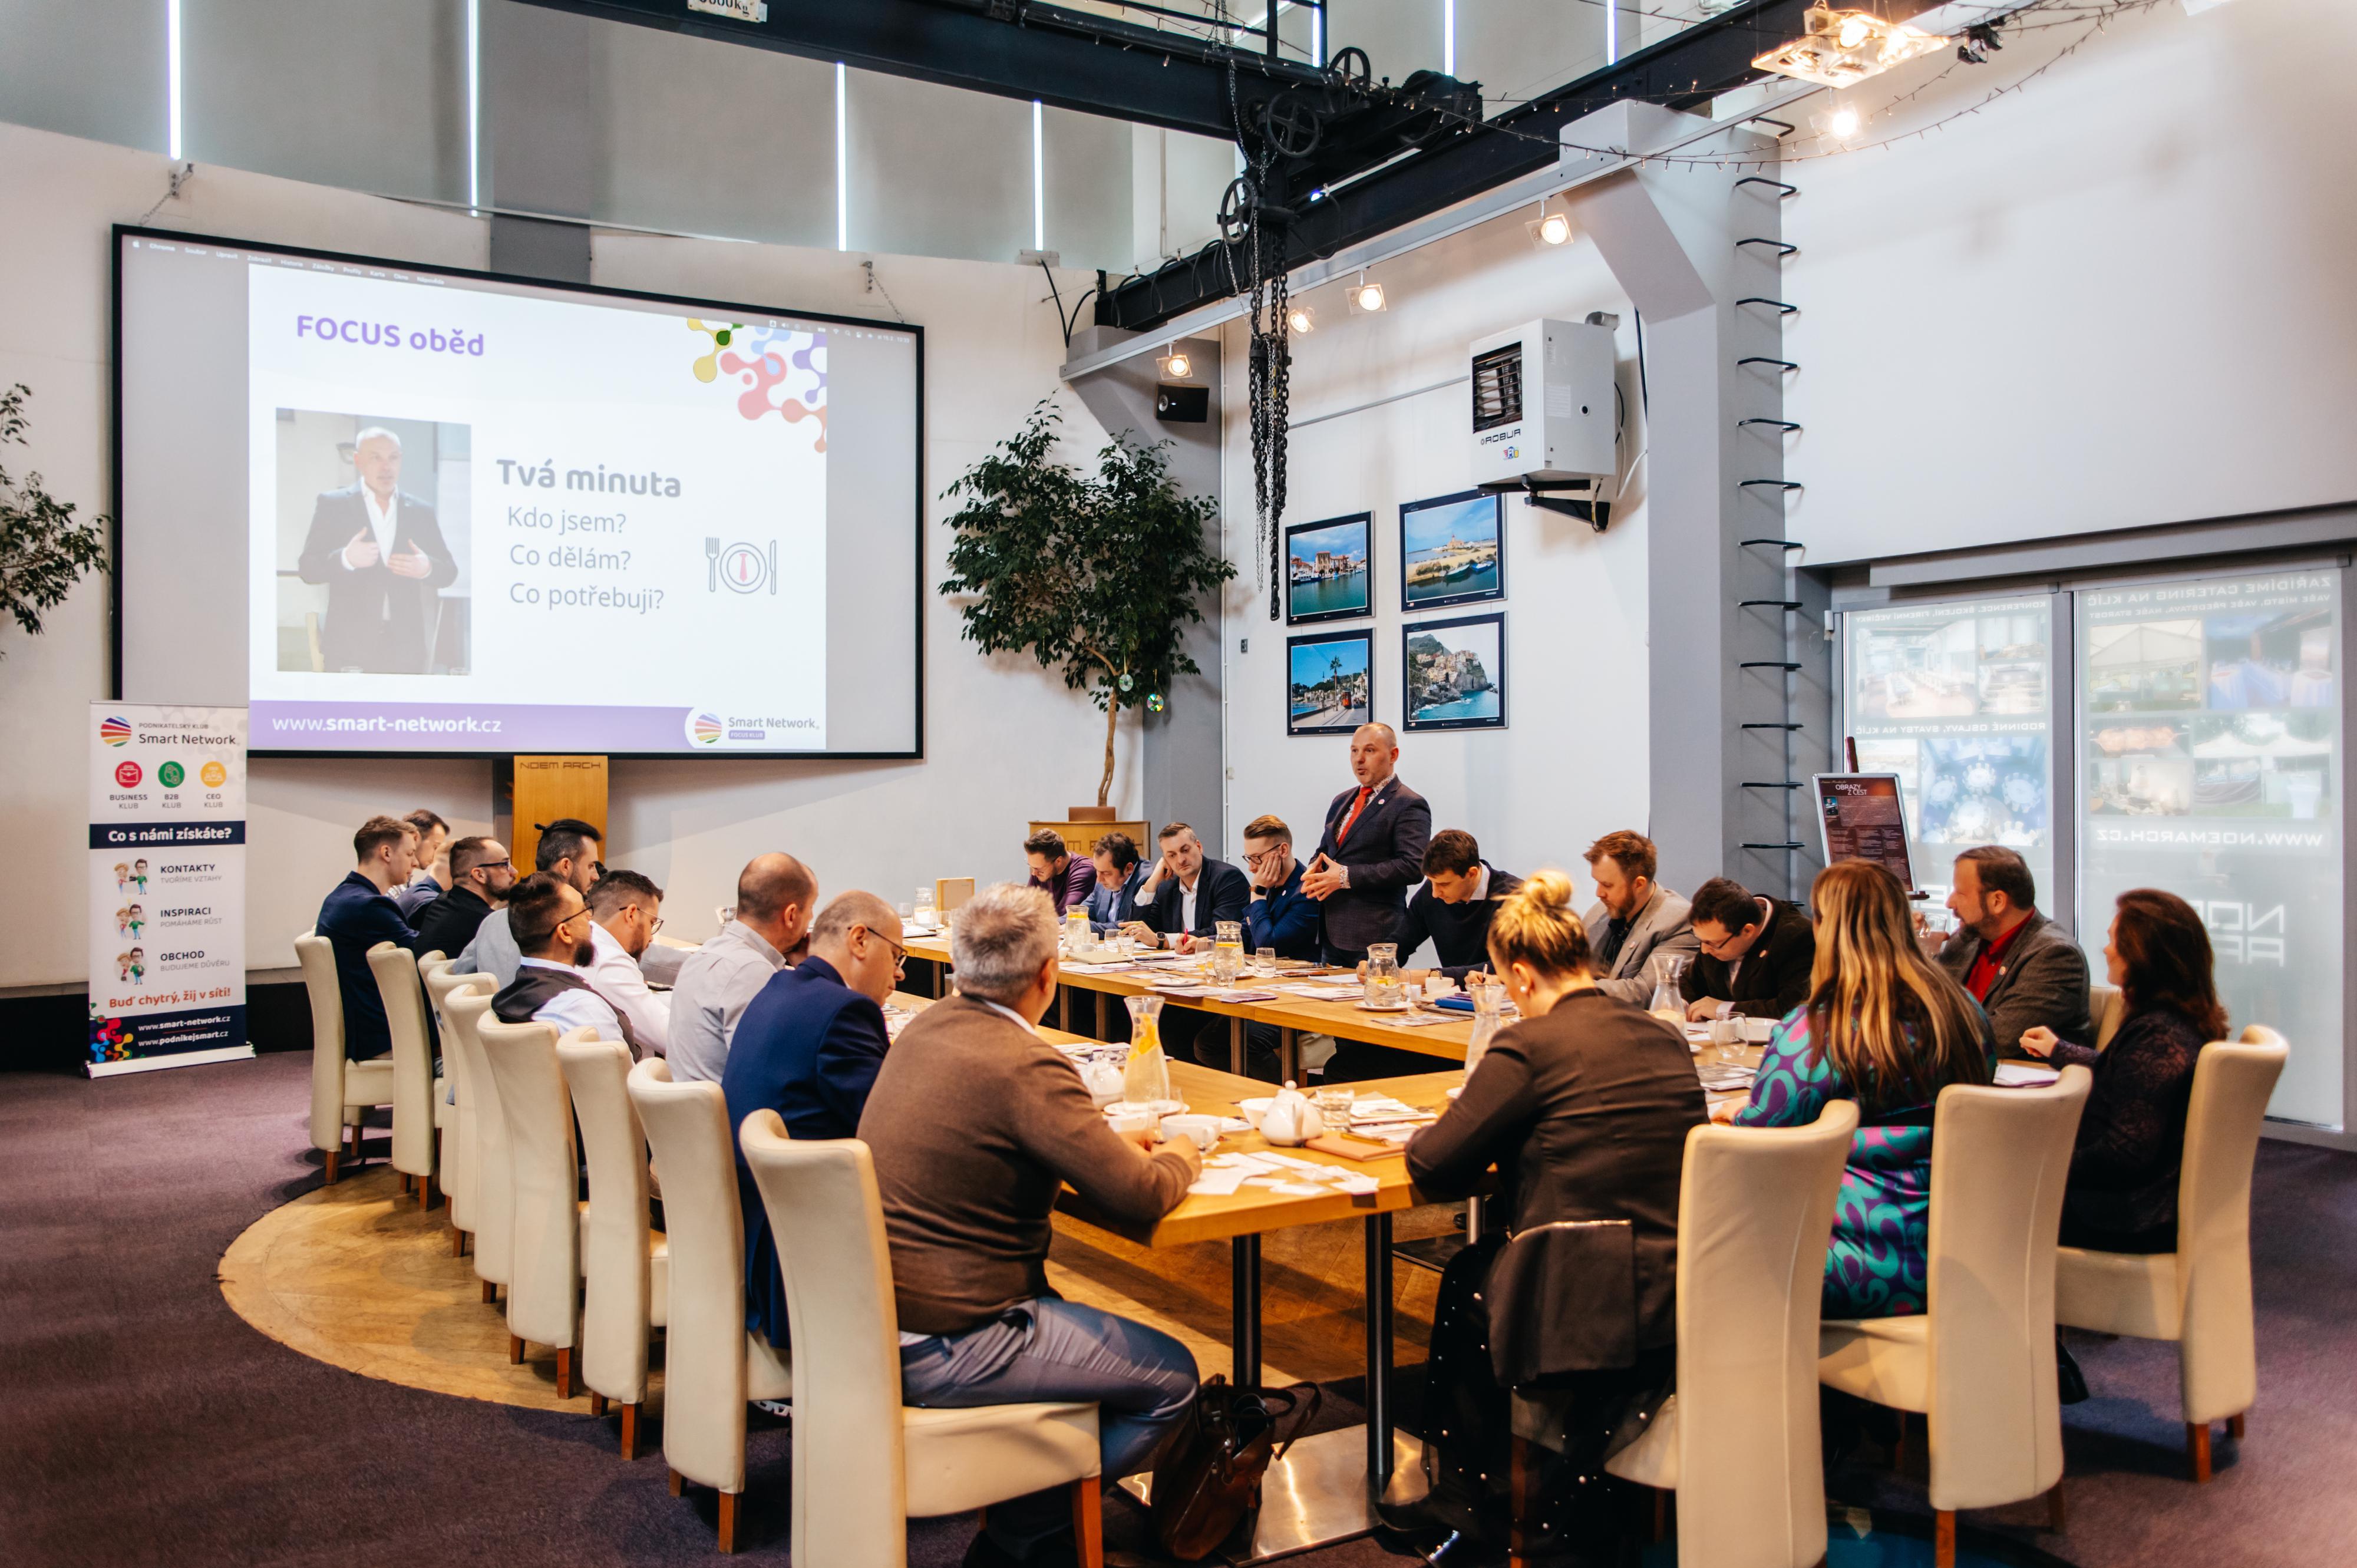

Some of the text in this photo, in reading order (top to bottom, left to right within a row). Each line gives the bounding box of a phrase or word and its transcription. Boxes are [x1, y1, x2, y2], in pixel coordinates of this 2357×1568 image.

[298, 315, 484, 356] FOCUS oběd
[1485, 428, 1521, 444] ROBUR
[496, 458, 681, 497] Tvá minuta
[508, 506, 626, 536] Kdo jsem?
[510, 544, 630, 570] Co dělám?
[510, 583, 664, 615] Co potřebuji?
[272, 716, 501, 733] www.smart-network.cz
[728, 717, 764, 728] Smart
[139, 734, 177, 744] Smart
[108, 827, 232, 841] Co s námi získáte?
[160, 864, 215, 873] KONTAKTY
[160, 907, 211, 917] INSPIRACI
[160, 919, 202, 927] POMÁHÁME
[160, 950, 204, 961] OBCHOD
[160, 963, 199, 972] BUDUJEME
[109, 997, 136, 1008] Buď
[138, 992, 180, 1006] chytrý,
[183, 990, 196, 1002] žij
[209, 988, 230, 998] síti!
[138, 1015, 231, 1031] www.smart-network.cz
[138, 1031, 229, 1047] www.podnikejsmart.cz
